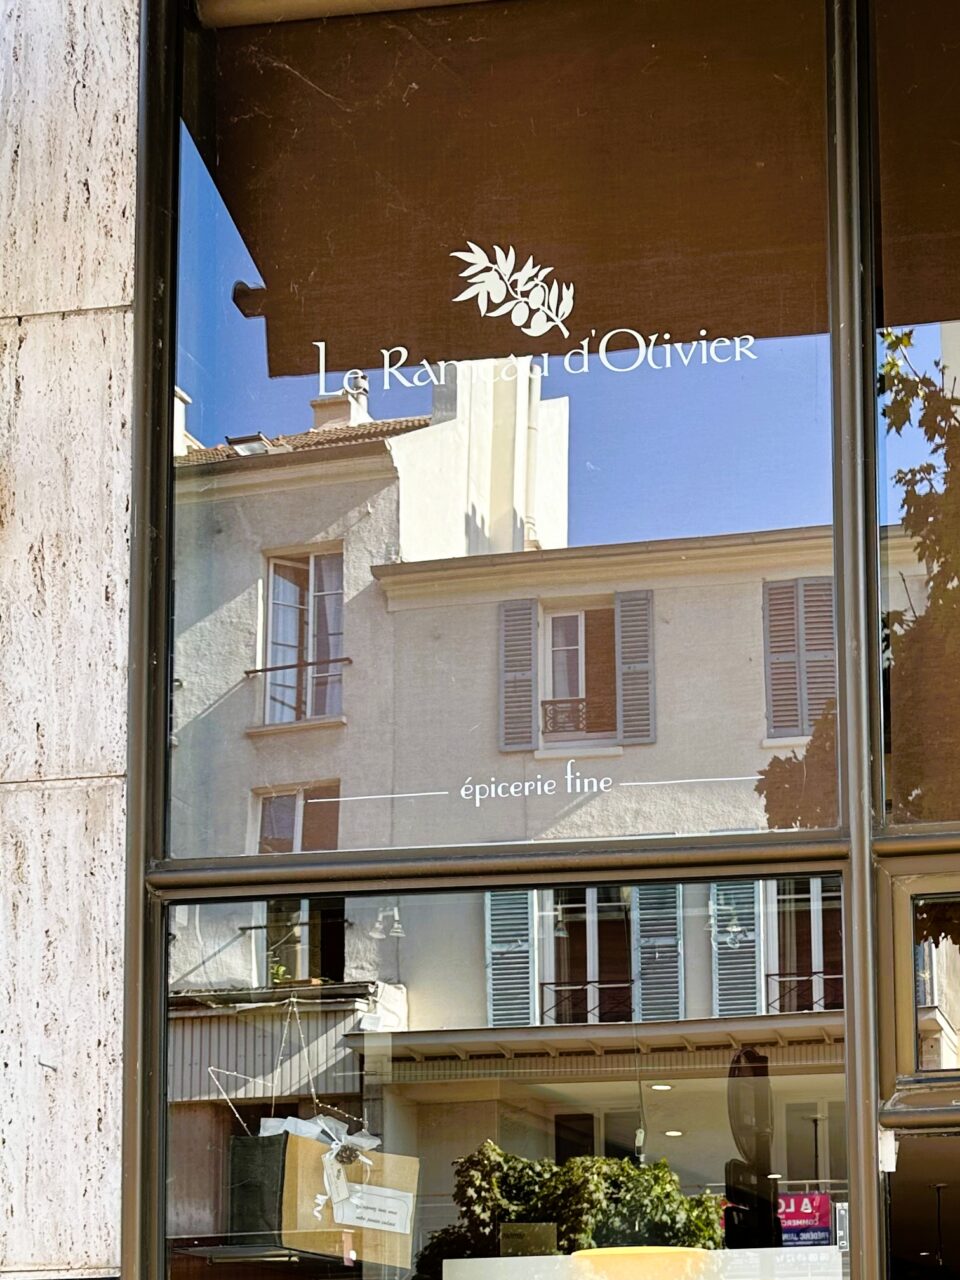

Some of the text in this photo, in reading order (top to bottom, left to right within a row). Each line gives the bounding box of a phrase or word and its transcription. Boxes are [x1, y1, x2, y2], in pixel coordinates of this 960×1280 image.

[312, 341, 369, 397] Le
[380, 346, 550, 390] Ramau
[459, 759, 613, 807] épicerie fine
